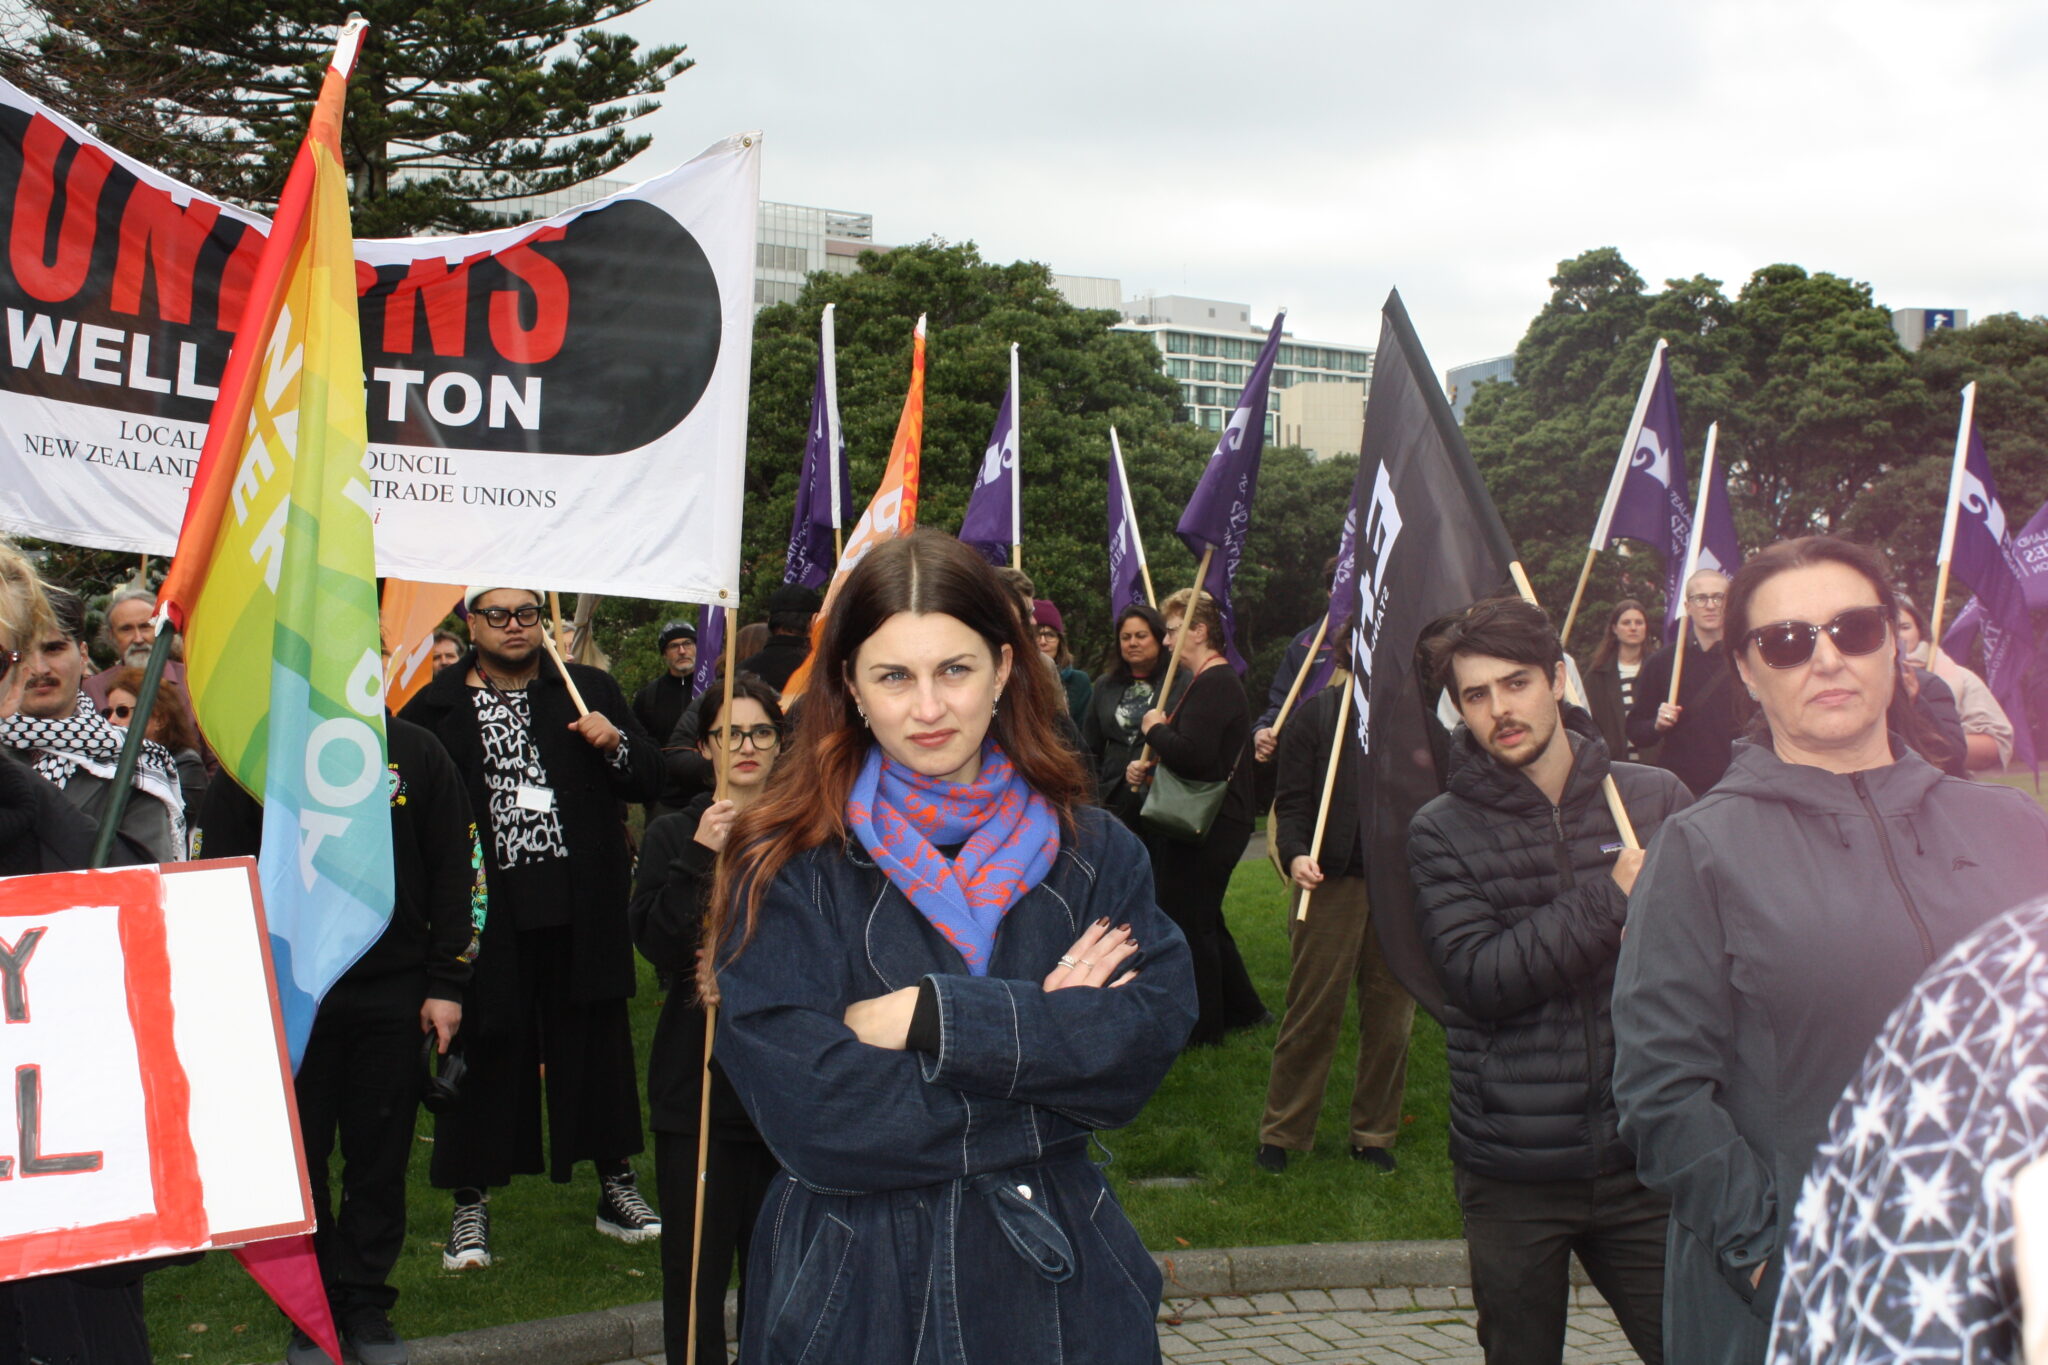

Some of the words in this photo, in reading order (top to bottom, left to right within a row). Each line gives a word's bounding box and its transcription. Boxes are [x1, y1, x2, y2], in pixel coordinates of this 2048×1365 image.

[9, 111, 570, 364] UNINS
[7, 307, 542, 430] WELLTON
[24, 434, 79, 459] NEW
[370, 479, 454, 503] TRADE
[462, 485, 556, 509] UNIONS
